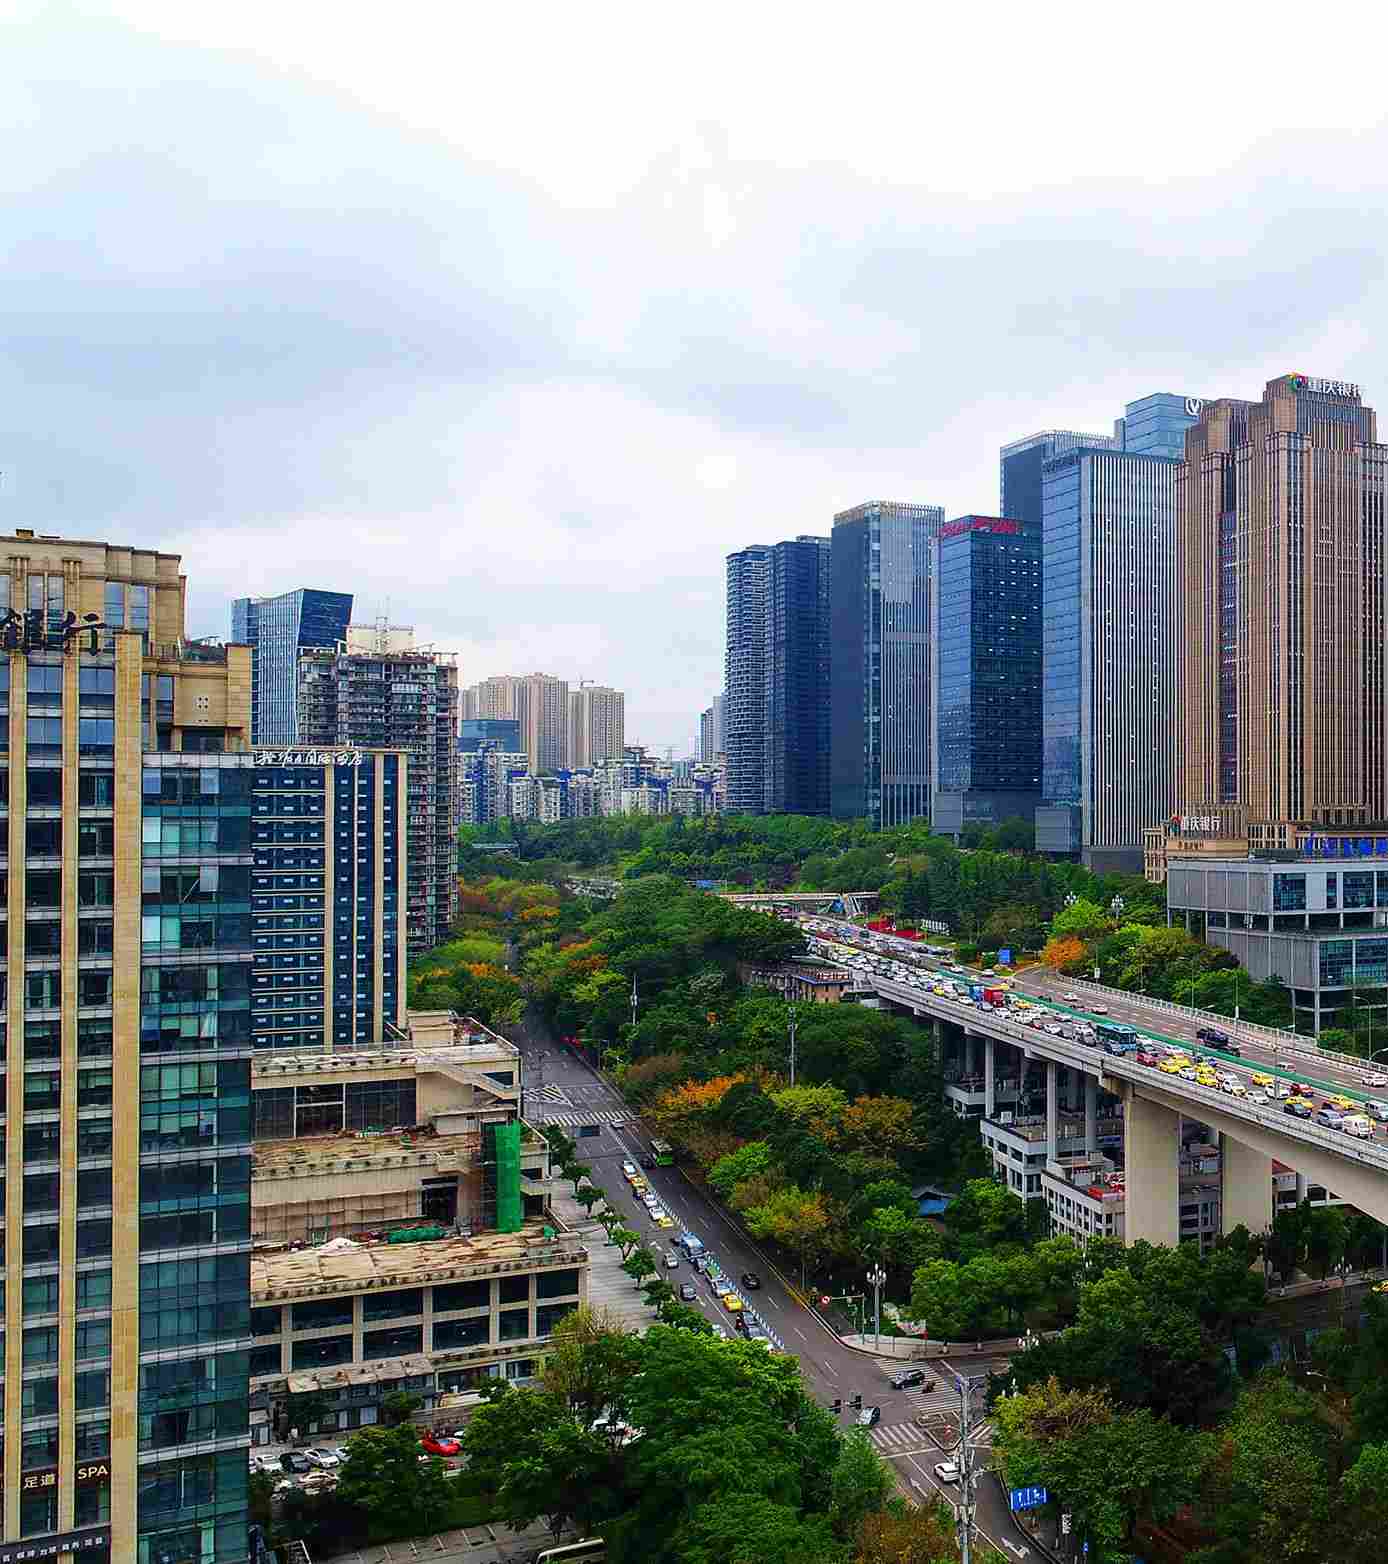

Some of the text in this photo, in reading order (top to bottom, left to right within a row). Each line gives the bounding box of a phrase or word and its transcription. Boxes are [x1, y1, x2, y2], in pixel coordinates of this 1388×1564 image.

[1181, 815, 1221, 833] 重庆银行
[23, 1464, 109, 1489] 足道 SPA
